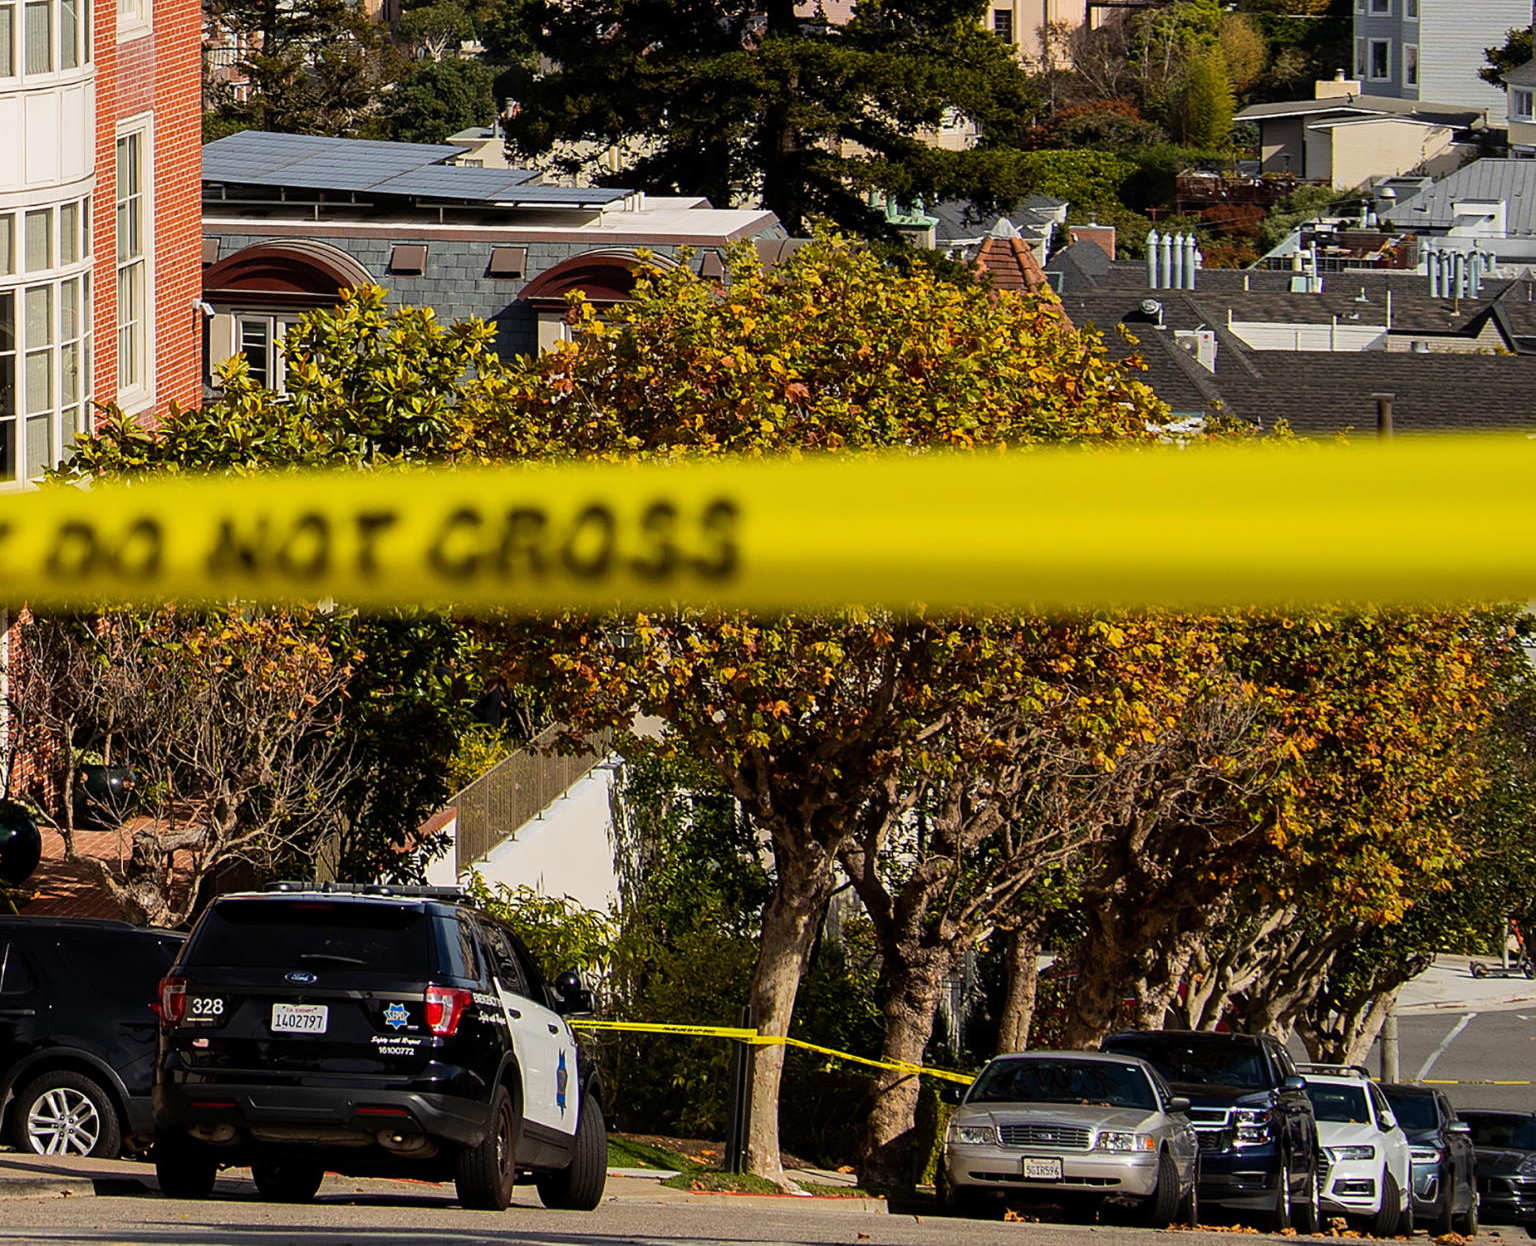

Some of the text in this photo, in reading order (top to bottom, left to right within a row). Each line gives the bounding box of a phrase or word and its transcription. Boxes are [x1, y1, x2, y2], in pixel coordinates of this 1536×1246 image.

[42, 512, 166, 582] DO
[202, 506, 400, 582] NOT
[424, 497, 737, 583] CROSS
[192, 998, 224, 1015] 328
[275, 1014, 323, 1029] 1402797
